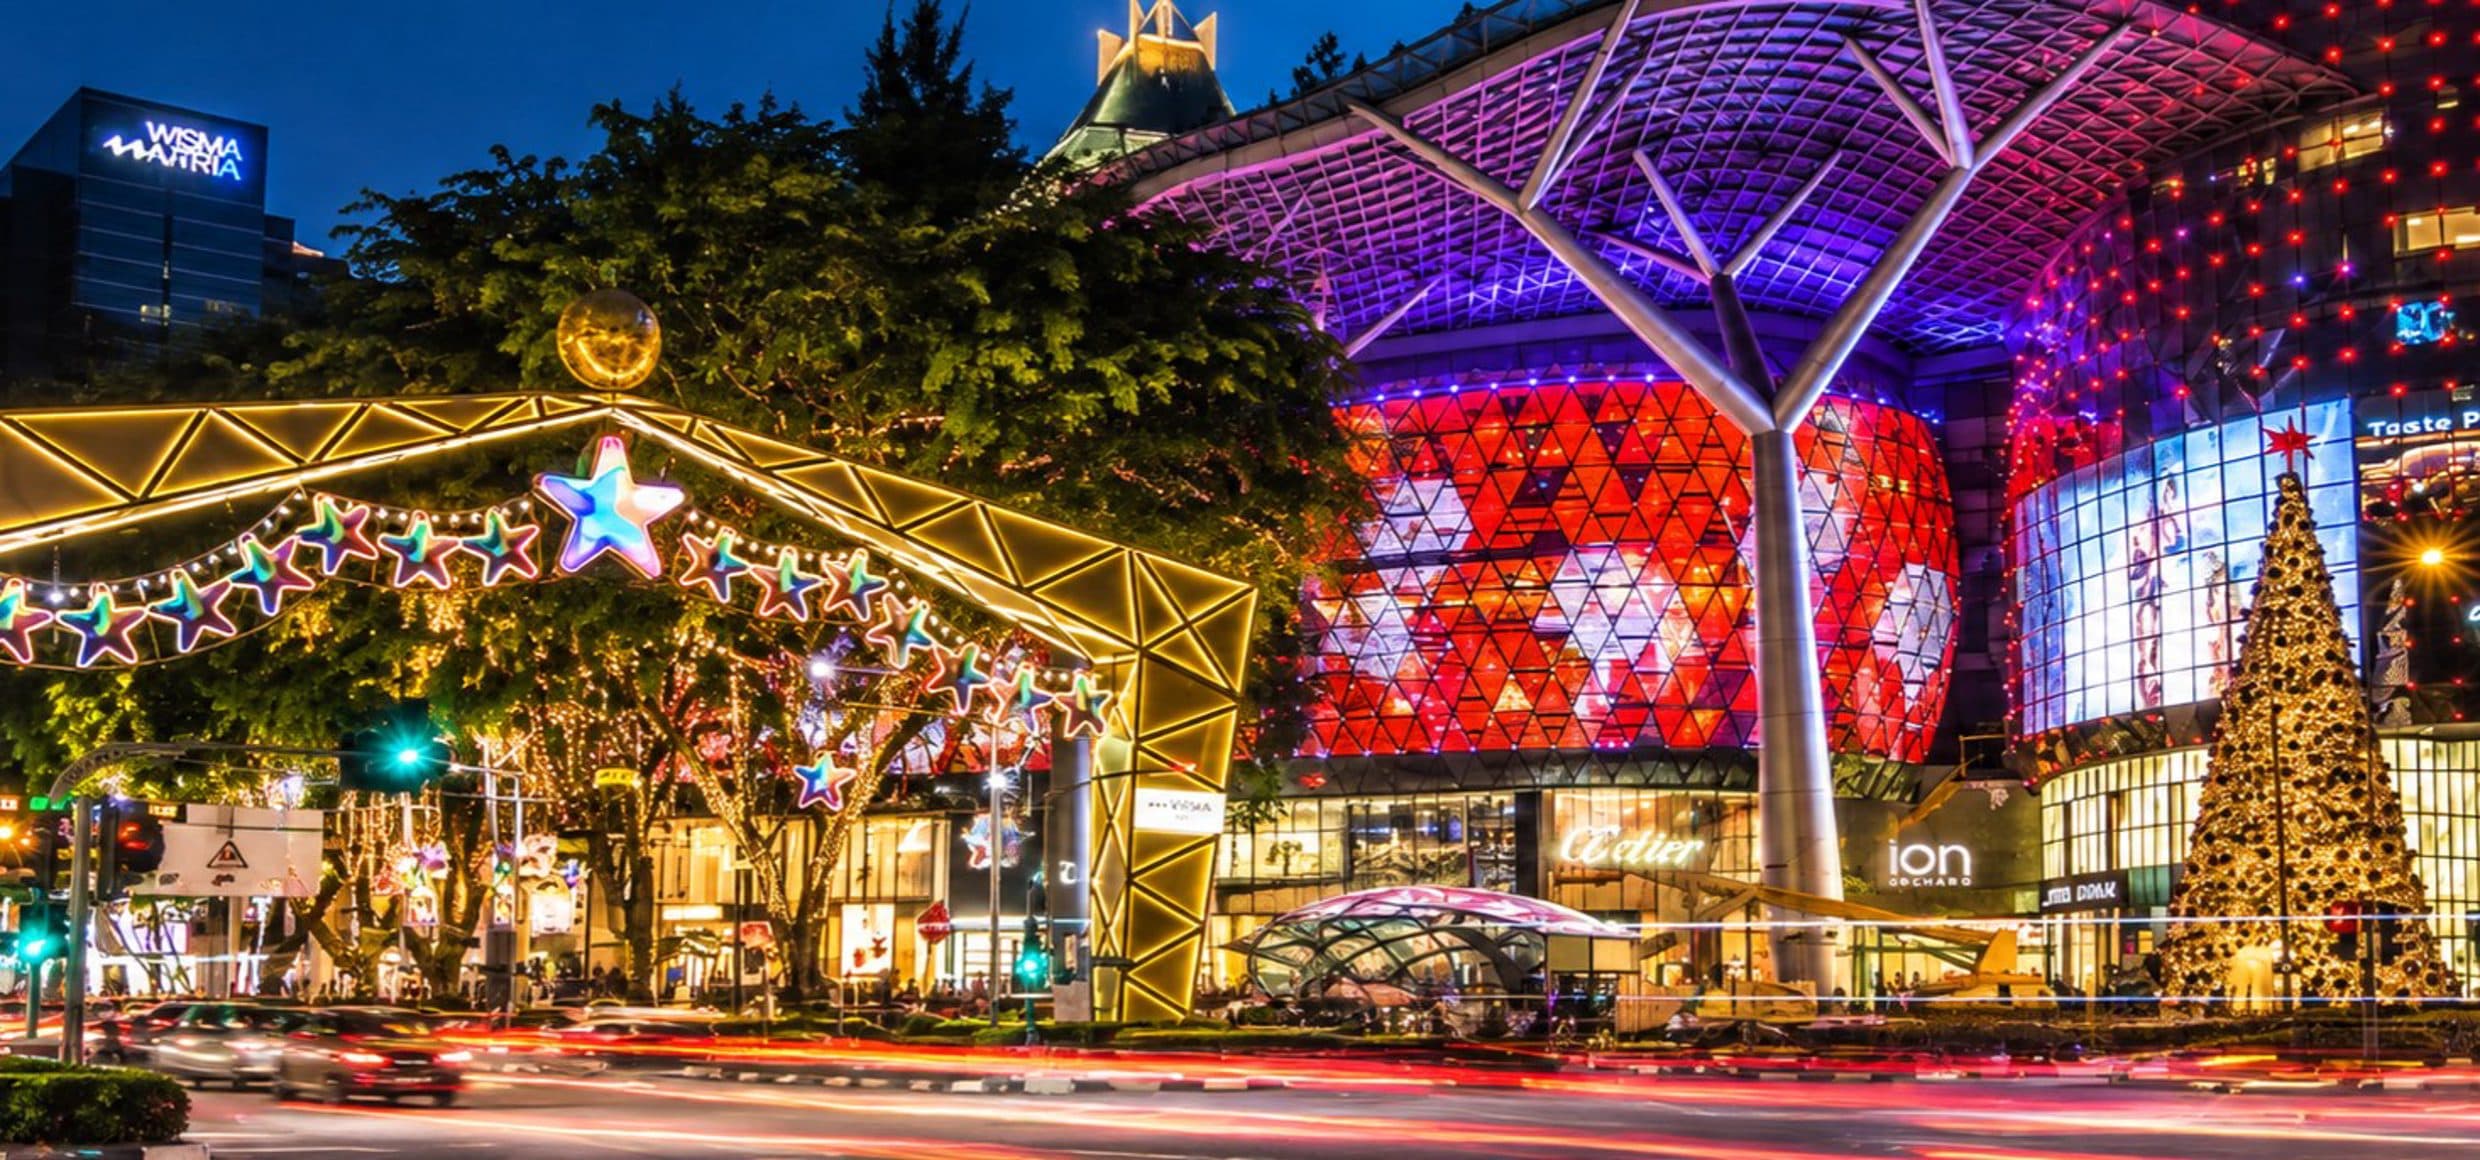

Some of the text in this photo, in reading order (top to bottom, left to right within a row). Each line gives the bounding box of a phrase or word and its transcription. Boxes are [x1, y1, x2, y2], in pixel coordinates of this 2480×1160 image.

[145, 121, 242, 161] WISMA
[2367, 416, 2452, 437] Taste
[1888, 838, 1972, 876] ion
